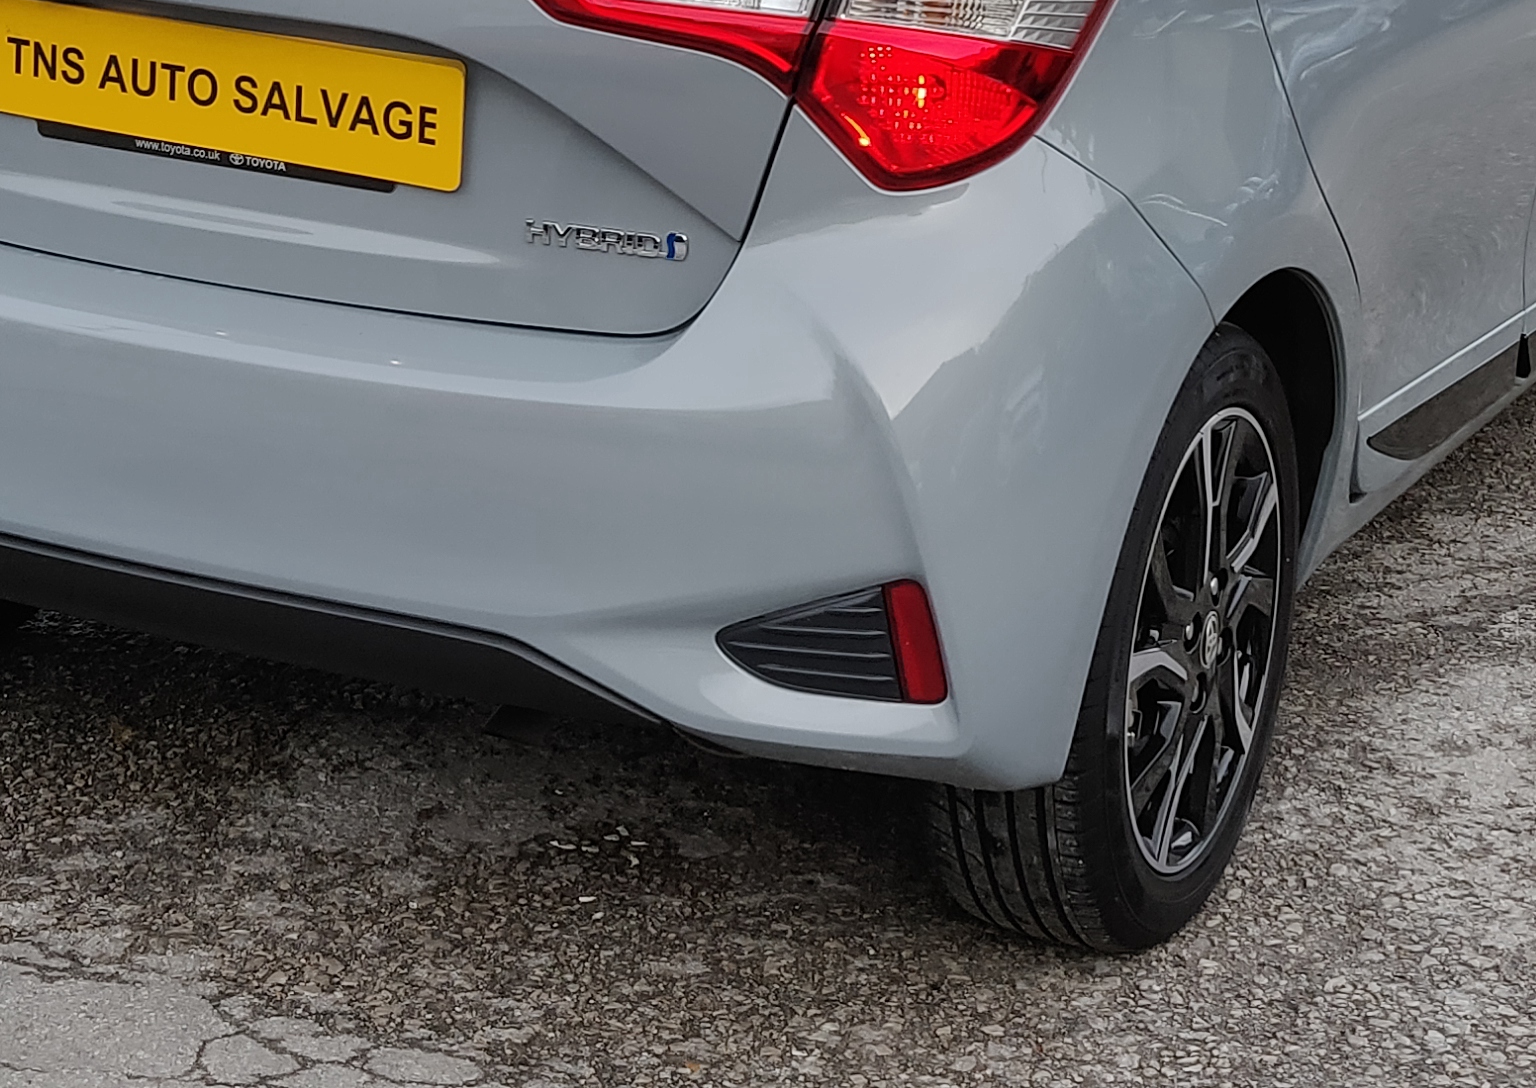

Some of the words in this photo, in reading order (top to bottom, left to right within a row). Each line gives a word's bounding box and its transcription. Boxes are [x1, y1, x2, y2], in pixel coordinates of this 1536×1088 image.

[6, 36, 85, 85] TNS
[98, 54, 219, 107] AUTO
[232, 75, 439, 146] SALVAGE
[135, 138, 221, 161] www.toyota.co.uk
[245, 156, 286, 171] TOYOTA
[525, 218, 662, 258] HYBRID
